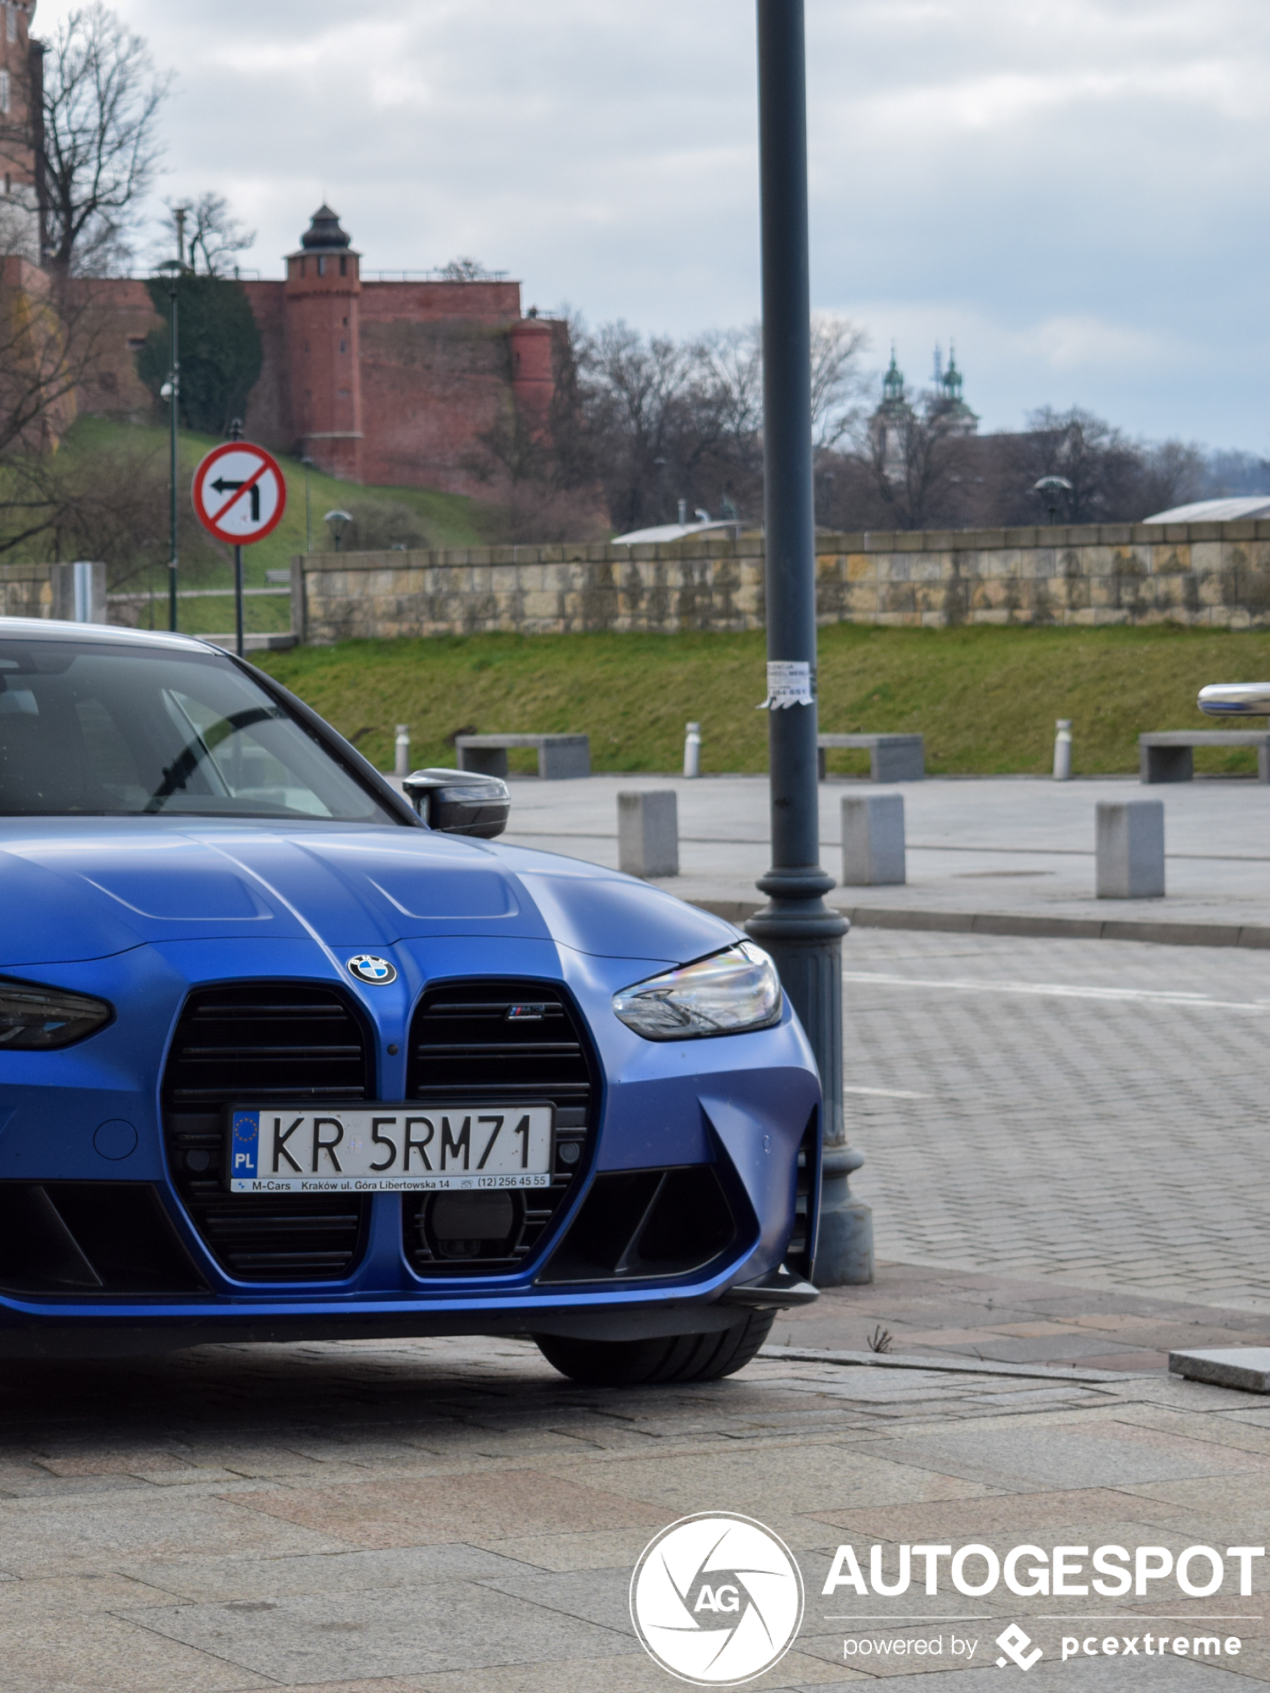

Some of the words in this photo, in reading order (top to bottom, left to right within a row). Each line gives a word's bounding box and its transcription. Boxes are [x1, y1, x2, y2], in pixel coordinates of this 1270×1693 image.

[272, 1116, 344, 1173] KR
[369, 1114, 531, 1173] 5RM71
[234, 1152, 255, 1169] PL
[252, 1180, 292, 1191] M-Cars
[301, 1179, 339, 1191] Kraków
[340, 1180, 353, 1190] ul.
[354, 1179, 378, 1190] Góra
[379, 1178, 437, 1191] Libertowska
[477, 1177, 498, 1188] (12)
[498, 1176, 518, 1187] 256
[519, 1175, 532, 1187] 45
[533, 1175, 547, 1186] 55
